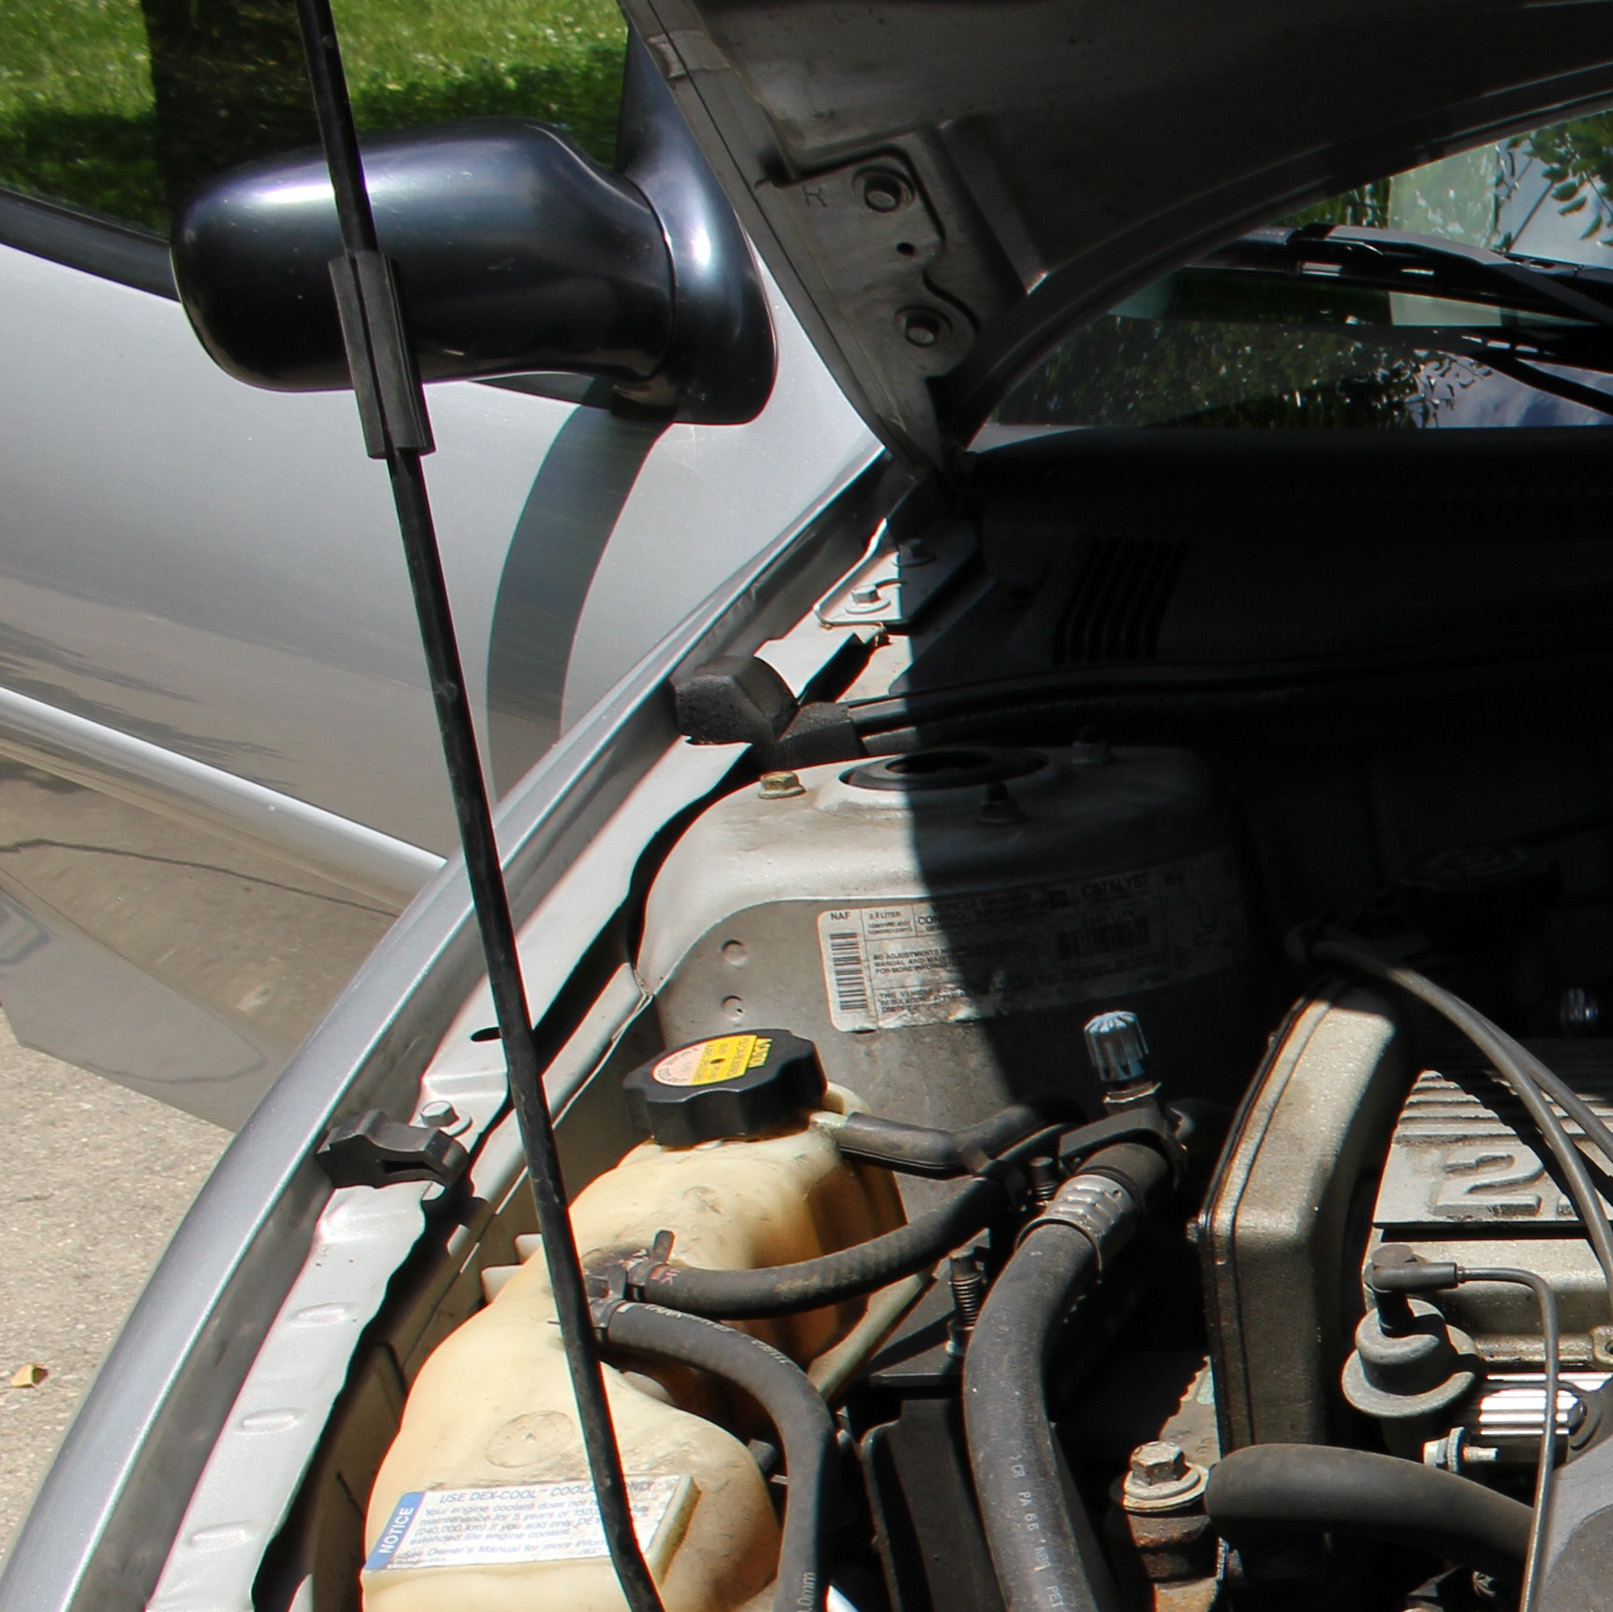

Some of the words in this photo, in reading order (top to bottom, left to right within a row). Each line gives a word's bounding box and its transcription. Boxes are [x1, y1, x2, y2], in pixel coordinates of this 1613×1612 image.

[1082, 872, 1148, 898] CATALYST
[830, 912, 850, 921] NAF
[440, 1493, 468, 1503] USE
[451, 1505, 489, 1514] engine
[493, 1503, 535, 1512] coolant
[569, 1500, 588, 1508] not
[419, 1514, 490, 1526] maintenance
[495, 1514, 508, 1522] for
[524, 1511, 554, 1521] years
[378, 1506, 415, 1554] NOTICE
[409, 1534, 461, 1545] extended
[485, 1532, 524, 1541] engine
[478, 1545, 521, 1553] Manual
